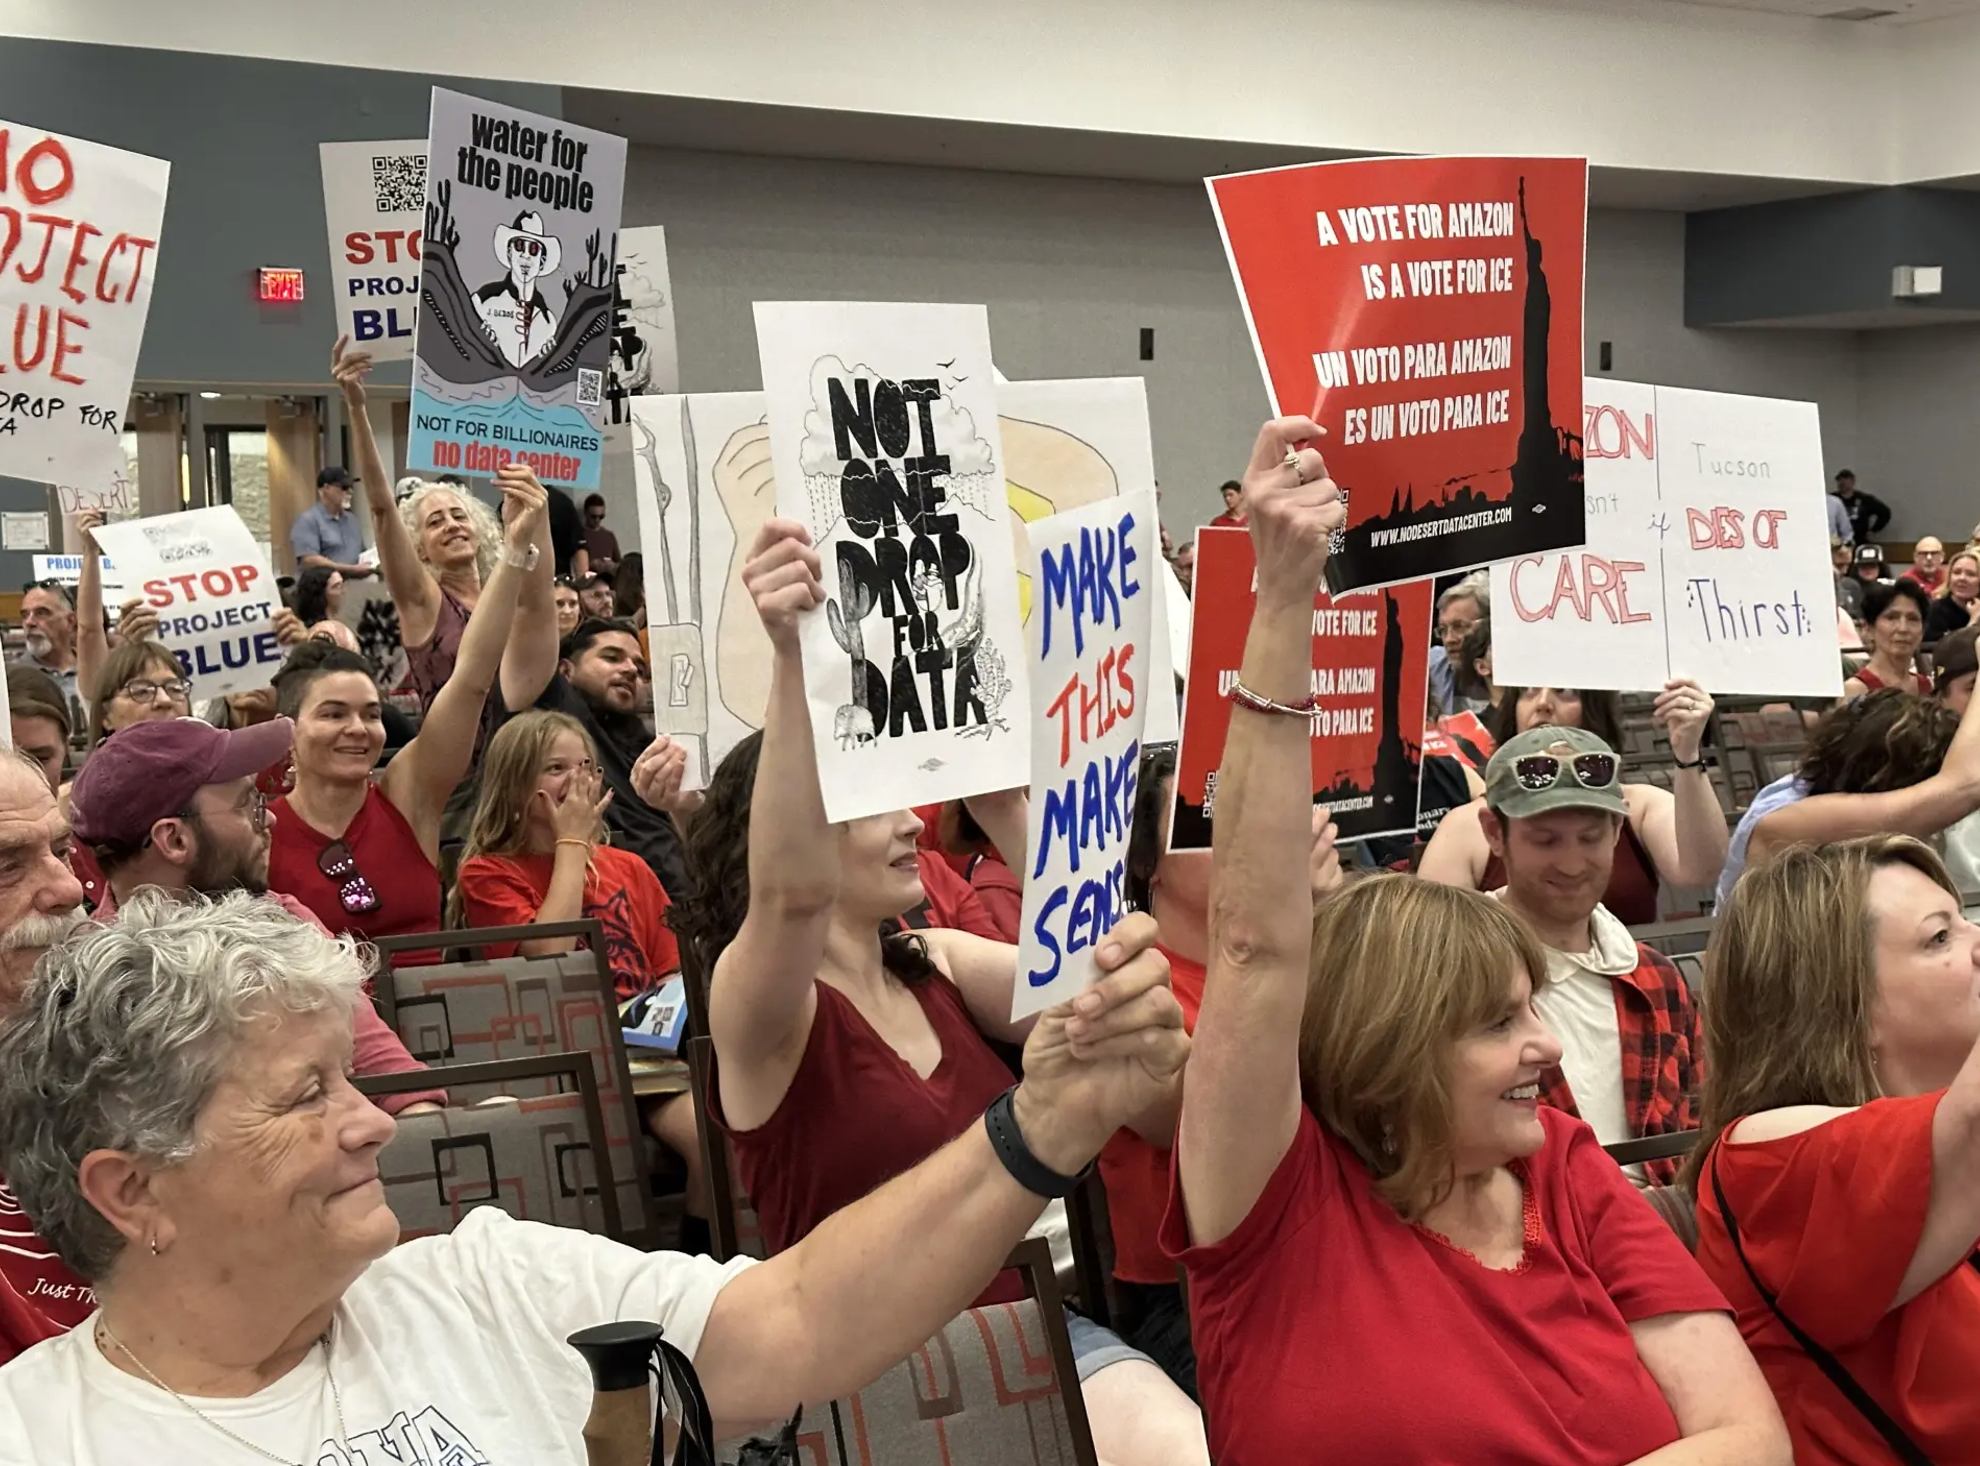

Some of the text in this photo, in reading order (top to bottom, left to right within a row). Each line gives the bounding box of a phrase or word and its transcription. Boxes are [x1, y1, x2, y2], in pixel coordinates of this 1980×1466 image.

[472, 113, 588, 173] water for
[0, 128, 74, 205] O
[458, 146, 594, 213] the people
[1316, 202, 1514, 246] A VOTE FOR AMAZON
[267, 273, 299, 298] EXIT
[348, 276, 419, 297] PROJ
[1360, 257, 1514, 300] IS A VOTE FOR ICE
[0, 303, 91, 385] UE
[353, 307, 418, 341] BL
[1312, 335, 1512, 389] UN VOTO PARA AMAZON
[79, 405, 118, 435] FOR
[417, 414, 599, 451] NOT FOR BILLIONAIRES
[828, 377, 941, 461] NOT
[1344, 389, 1510, 445] ES UN VOTO PARA ICE
[433, 440, 582, 482] no data center
[1691, 442, 1771, 479] Tucson
[59, 479, 129, 514] DESERT
[840, 454, 960, 539] ONE
[1370, 506, 1513, 548] WWW.NODESERTDATACENTER.COM
[1647, 512, 1672, 540] if
[1686, 506, 1788, 551] DIES OF
[143, 564, 259, 608] STOP
[836, 533, 971, 619] DROP
[1041, 512, 1142, 661] MAKE
[1509, 553, 1652, 624] CARE
[156, 601, 271, 640] PROJECT
[1341, 609, 1361, 636] FOR
[1362, 609, 1378, 636] ICE
[1688, 577, 1803, 643] Thirst
[893, 611, 942, 657] FOR
[856, 646, 988, 742] DATA
[1310, 667, 1376, 696] ARA AMAZON
[1046, 642, 1136, 768] THIS
[1332, 711, 1357, 736] PARA
[1359, 707, 1374, 734] ICE
[1033, 738, 1138, 880] MAKE
[27, 1277, 76, 1298] Just
